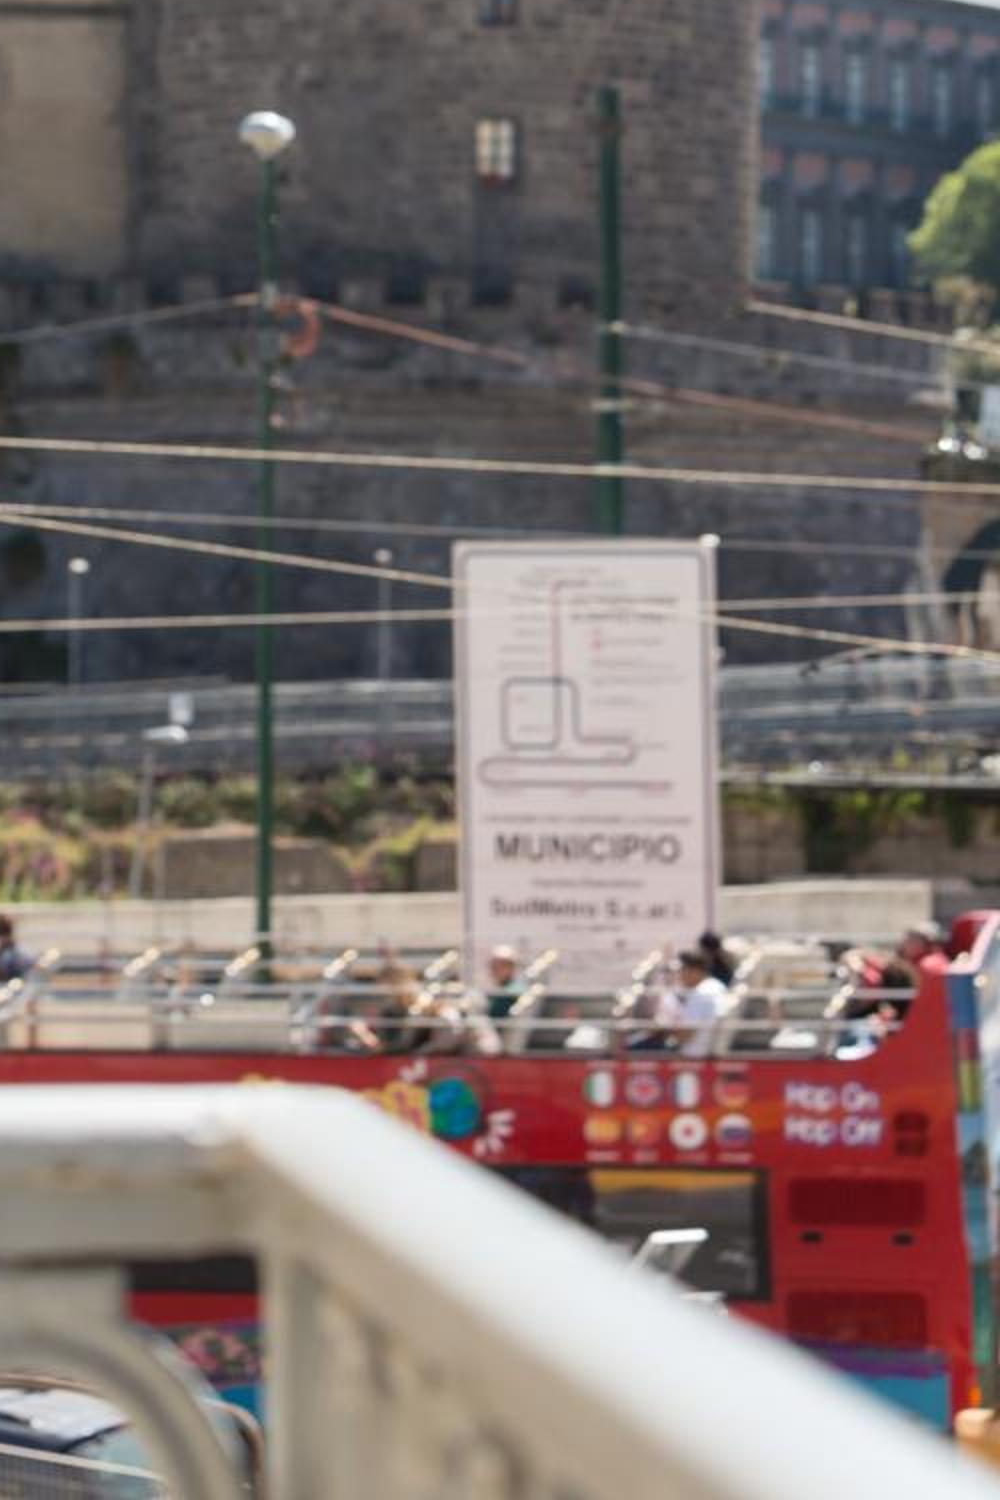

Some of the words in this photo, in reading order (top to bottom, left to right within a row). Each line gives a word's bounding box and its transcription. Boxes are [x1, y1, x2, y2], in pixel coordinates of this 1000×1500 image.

[494, 832, 682, 865] MUNICIPIO
[784, 1080, 835, 1112] Hop
[840, 1081, 880, 1112] On
[784, 1114, 836, 1146] Hop
[840, 1115, 884, 1146] Off
